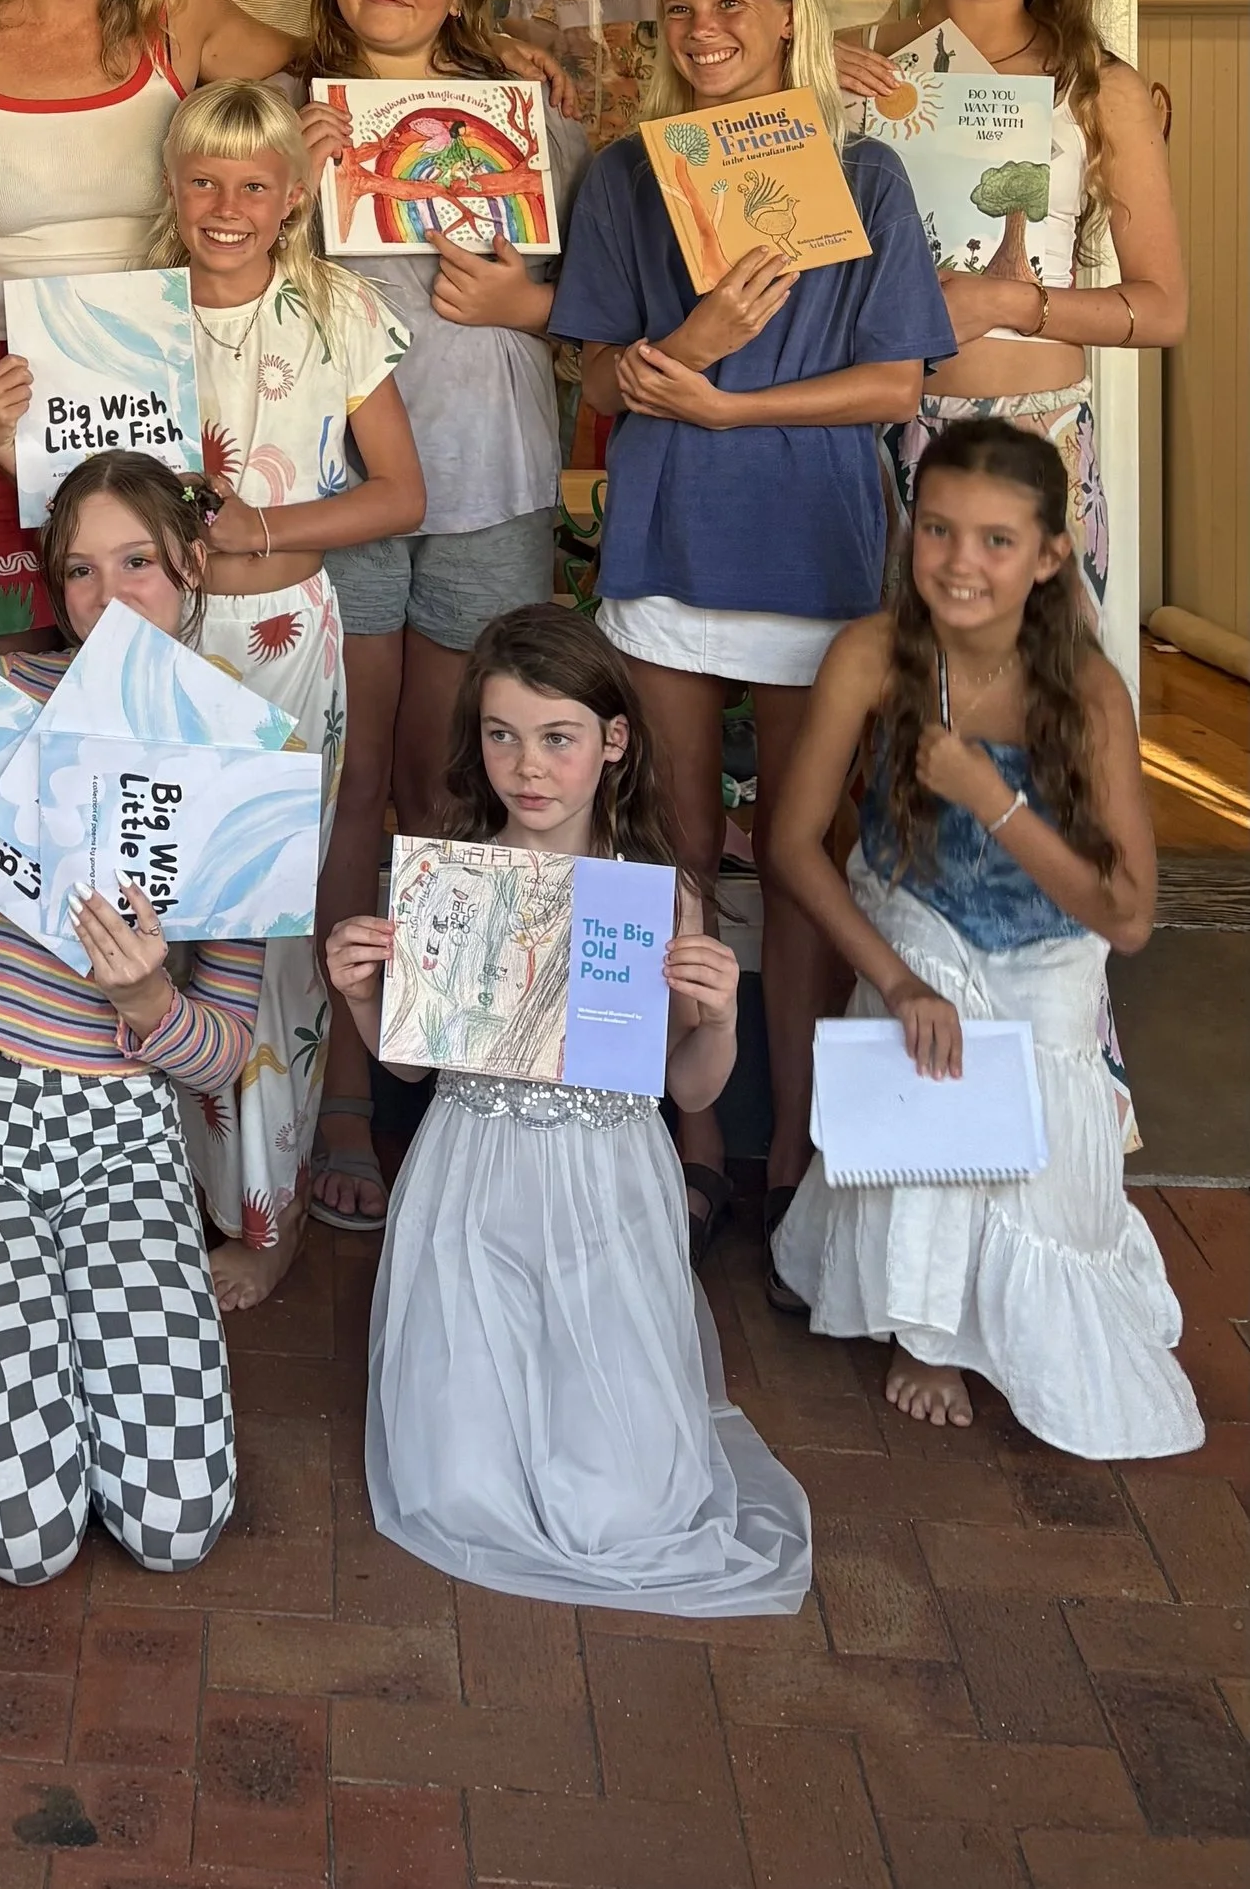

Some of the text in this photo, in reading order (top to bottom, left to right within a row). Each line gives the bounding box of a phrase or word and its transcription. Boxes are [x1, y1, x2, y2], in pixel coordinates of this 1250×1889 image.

[408, 92, 425, 102] the
[427, 91, 465, 102] Magical
[467, 96, 493, 113] Fairy
[968, 89, 1016, 101] DO YOU
[964, 102, 1019, 114] WANT TO
[712, 108, 790, 136] Finding
[958, 116, 1023, 128] PLAY WITH
[720, 119, 817, 156] Friends
[746, 147, 785, 161] Australian
[786, 142, 805, 152] Bush
[48, 391, 167, 429] Big Wish
[45, 418, 183, 453] Little Fish
[120, 773, 150, 858] Little
[143, 783, 182, 915] Big Wish
[582, 918, 654, 947] The Big
[582, 940, 616, 960] Old
[581, 961, 630, 983] Pond
